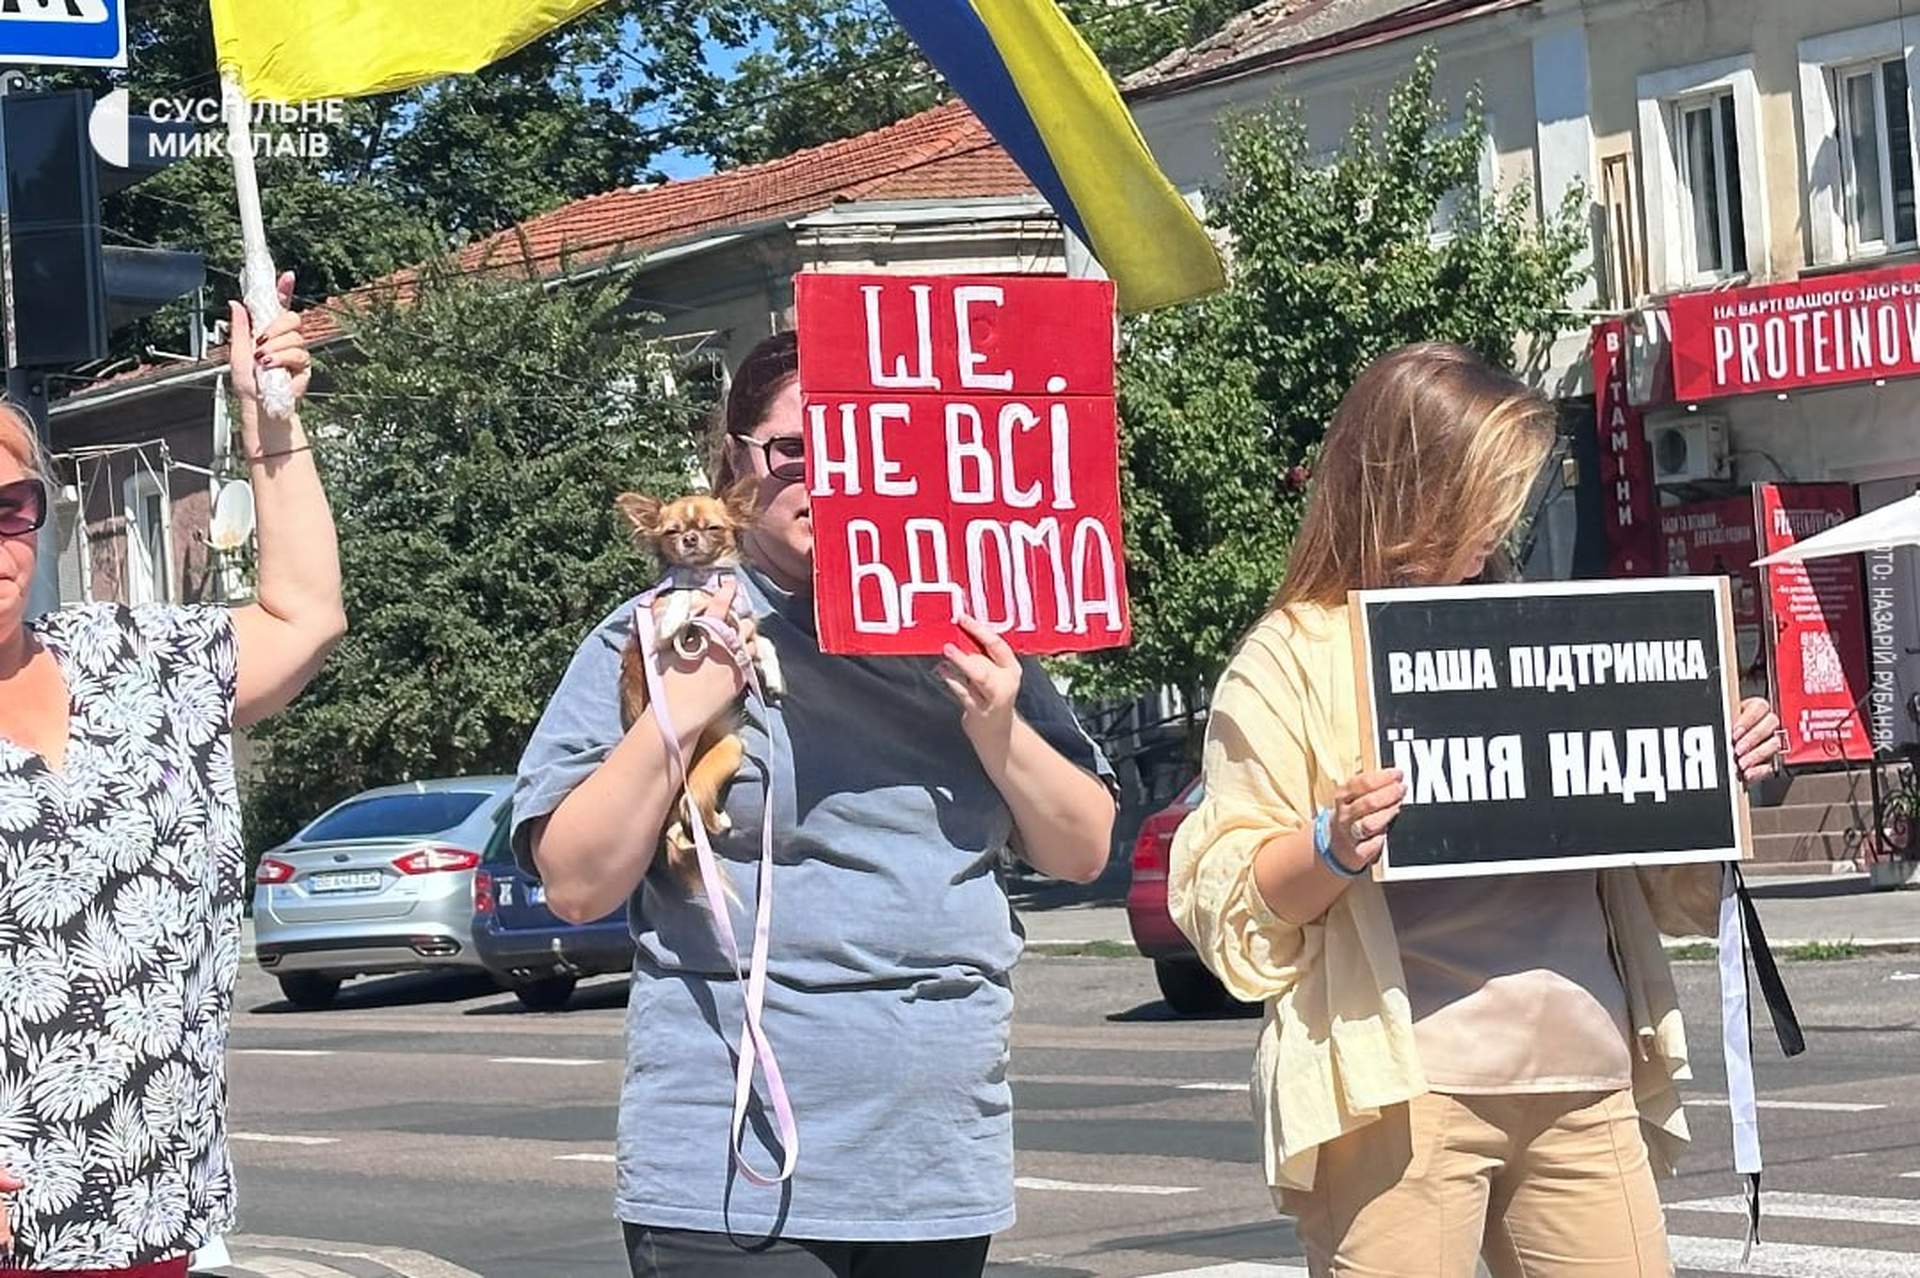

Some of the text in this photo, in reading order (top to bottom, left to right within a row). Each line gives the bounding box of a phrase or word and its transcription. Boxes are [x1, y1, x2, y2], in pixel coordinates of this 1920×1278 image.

[1713, 305, 1735, 320] НА
[1738, 299, 1782, 316] ВАРТІ
[1786, 290, 1853, 310] ВАШОГО
[807, 402, 917, 497] НЕ
[847, 517, 1124, 635] ВДОМА
[1388, 639, 1708, 694] ВАША ПІДТРИМКА
[1388, 728, 1526, 804] ЇХНЯ
[1548, 725, 1718, 804] НАДІЯ
